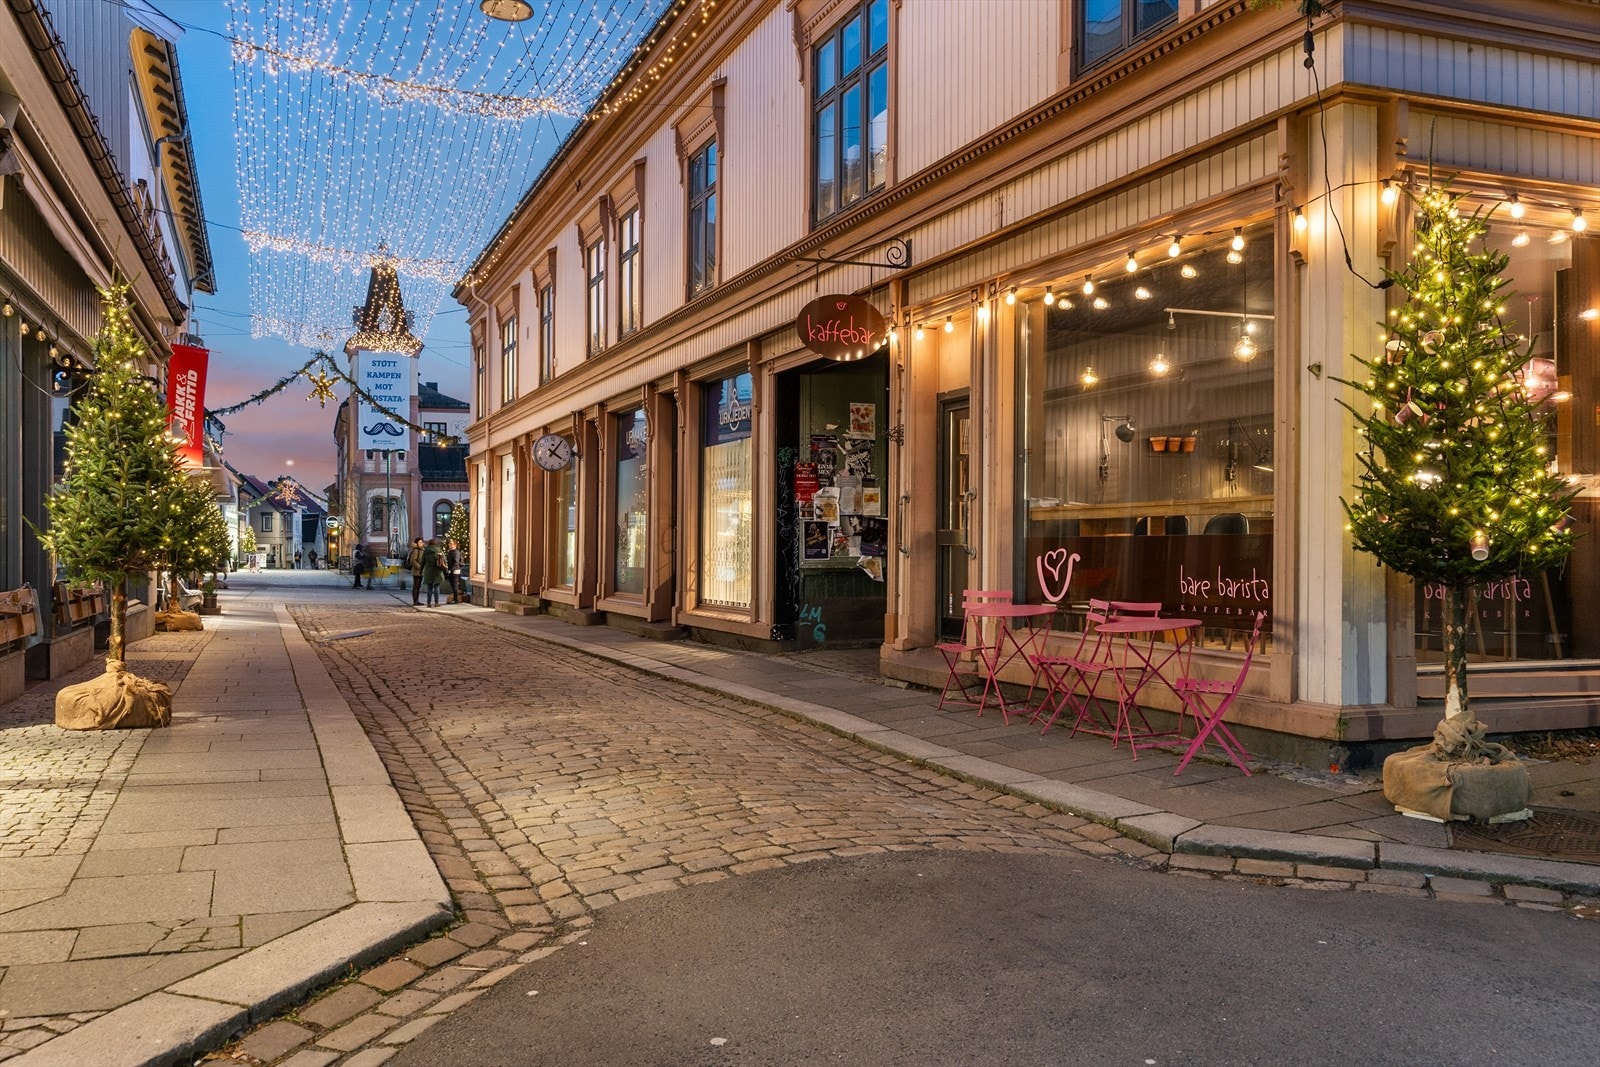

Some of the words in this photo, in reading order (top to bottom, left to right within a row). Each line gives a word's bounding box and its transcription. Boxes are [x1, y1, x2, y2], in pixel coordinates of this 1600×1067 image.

[807, 314, 875, 346] kaffebar
[371, 359, 397, 368] STØTT
[176, 373, 187, 385] &
[366, 371, 402, 379] KAMPEN
[374, 383, 393, 391] MOT
[185, 369, 198, 421] FRITID
[174, 383, 188, 427] JAKK
[1180, 564, 1211, 599] bare
[1217, 565, 1269, 602] barista
[1180, 604, 1268, 617] KAFFEBAR
[1424, 610, 1531, 619] KAFEBAR
